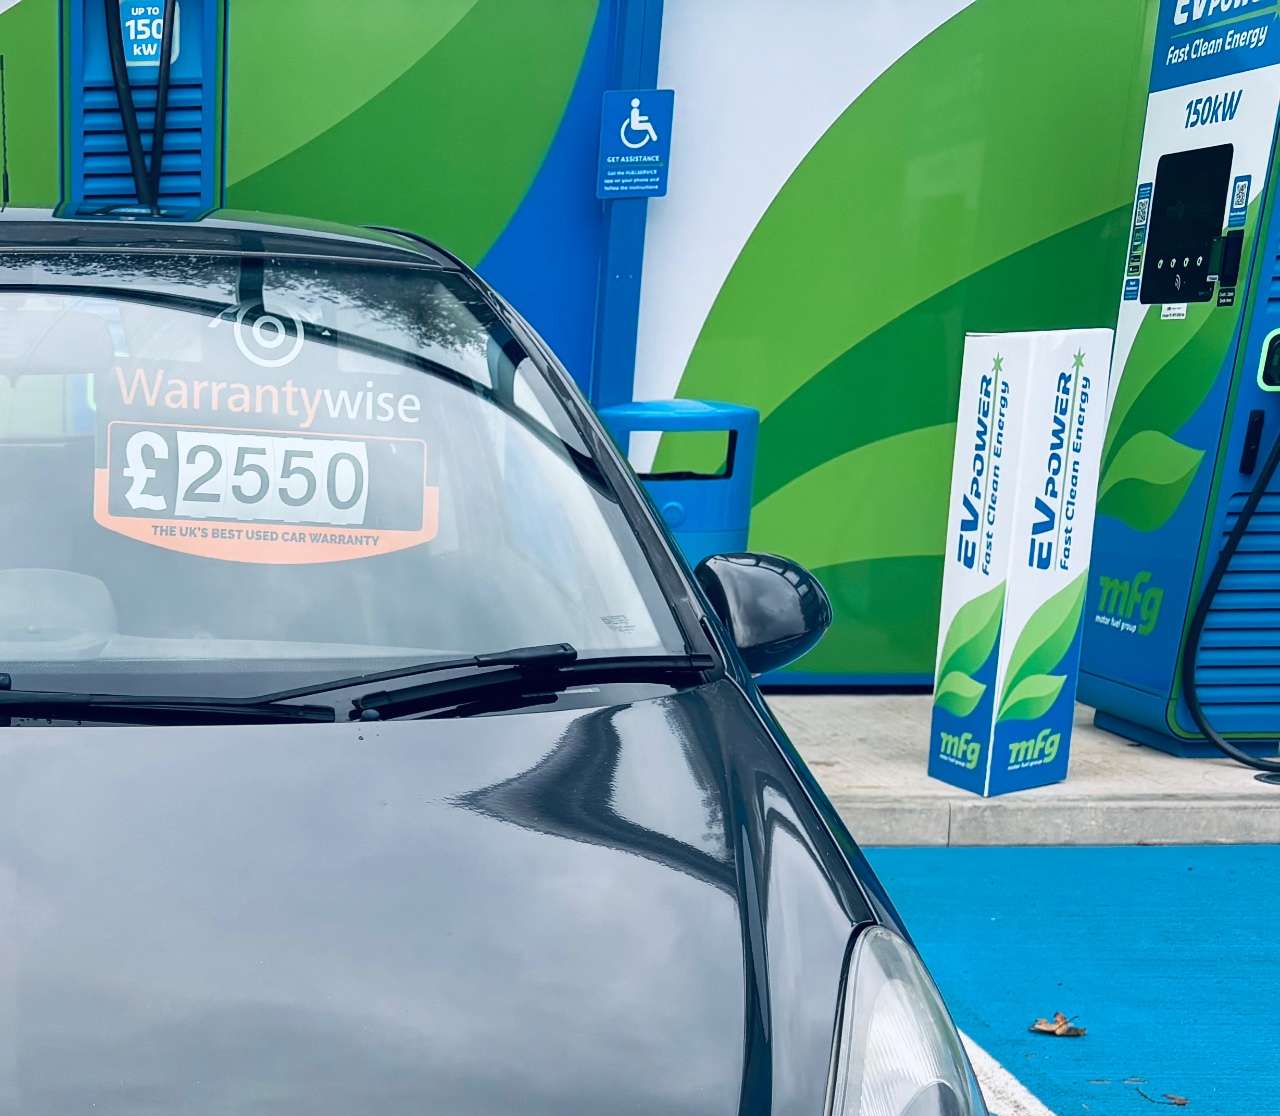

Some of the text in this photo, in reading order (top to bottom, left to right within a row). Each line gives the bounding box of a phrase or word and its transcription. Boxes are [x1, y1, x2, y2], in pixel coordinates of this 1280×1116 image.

[125, 19, 164, 40] 150
[131, 7, 159, 15] UP TO
[133, 43, 157, 55] kW
[1165, 25, 1268, 65] Fast Clean Energy
[1185, 88, 1243, 128] 150kW
[114, 367, 421, 429] Warrantywise
[122, 430, 364, 512] £2550
[981, 380, 1010, 576] Fast Clean Energy
[1060, 376, 1091, 571] Fast Clean Energy
[151, 525, 380, 547] THE UK'S BEST USED CAR WARRANTY
[1098, 570, 1164, 636] mfg
[940, 732, 980, 769] mfg
[1008, 728, 1061, 763] mfg
